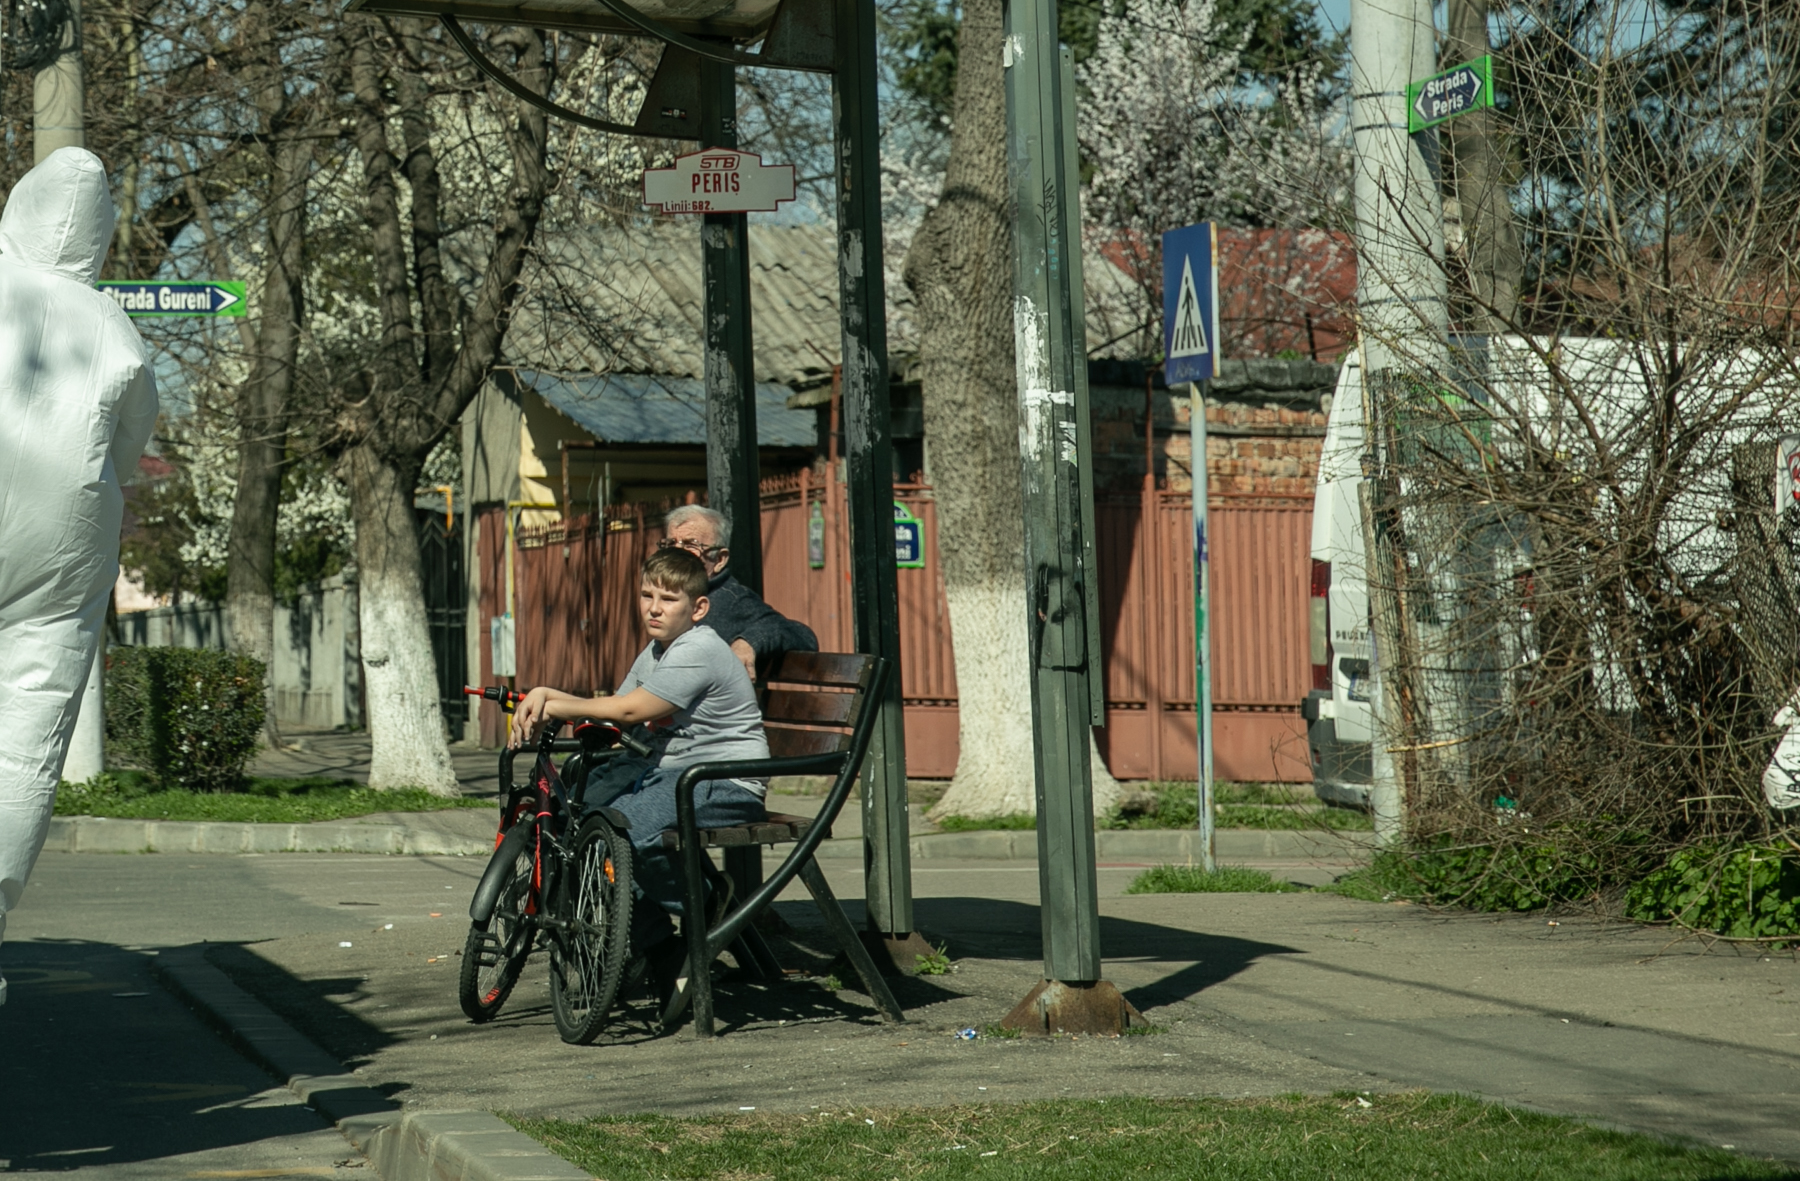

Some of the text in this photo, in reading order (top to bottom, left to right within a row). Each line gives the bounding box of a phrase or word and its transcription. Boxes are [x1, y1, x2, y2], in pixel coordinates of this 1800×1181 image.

[1426, 70, 1468, 98] Strada
[700, 156, 736, 169] STB
[159, 286, 211, 311] Gureni
